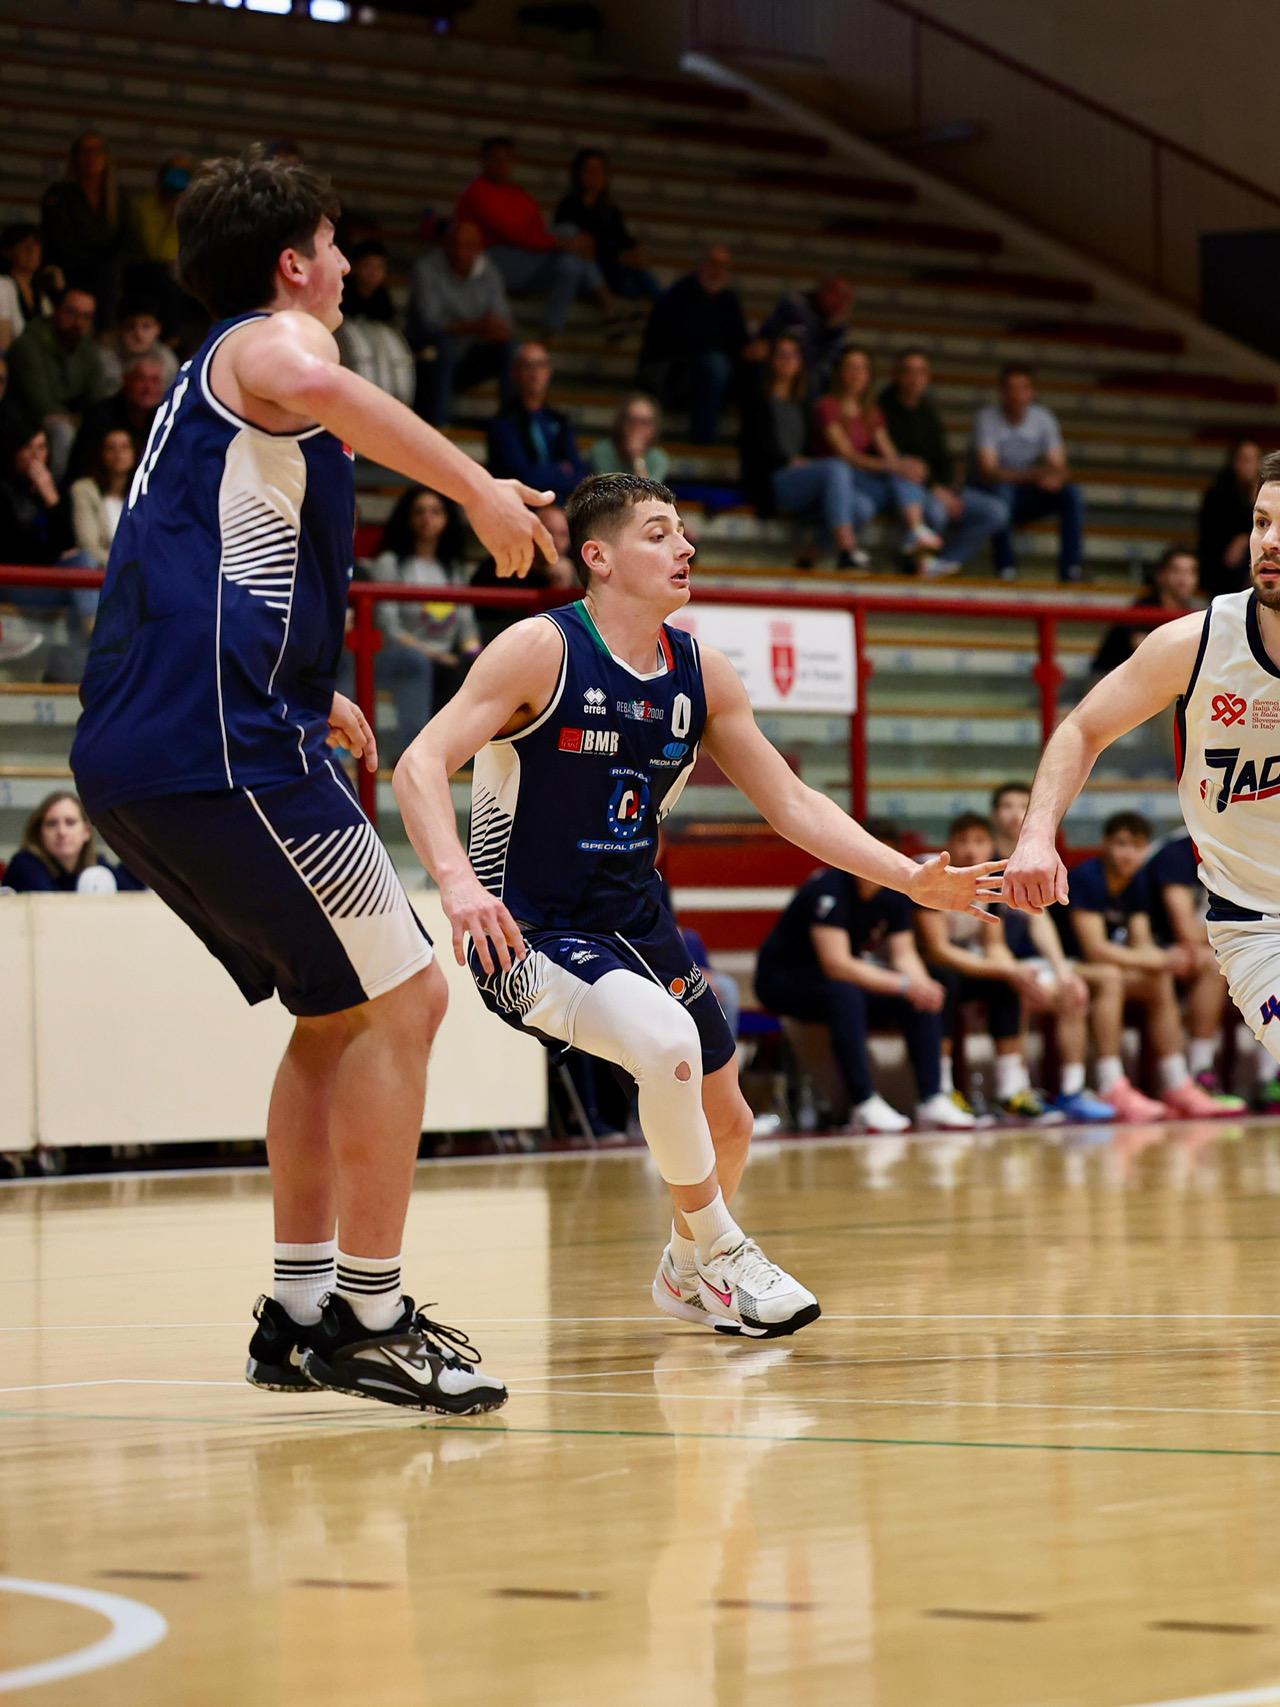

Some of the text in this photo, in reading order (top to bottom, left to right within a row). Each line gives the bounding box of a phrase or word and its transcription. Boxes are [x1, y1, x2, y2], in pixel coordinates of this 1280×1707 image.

[647, 707, 664, 720] 2000
[671, 692, 691, 739] 0
[584, 730, 619, 752] BMR
[581, 840, 650, 851] SPECIAL STEEL
